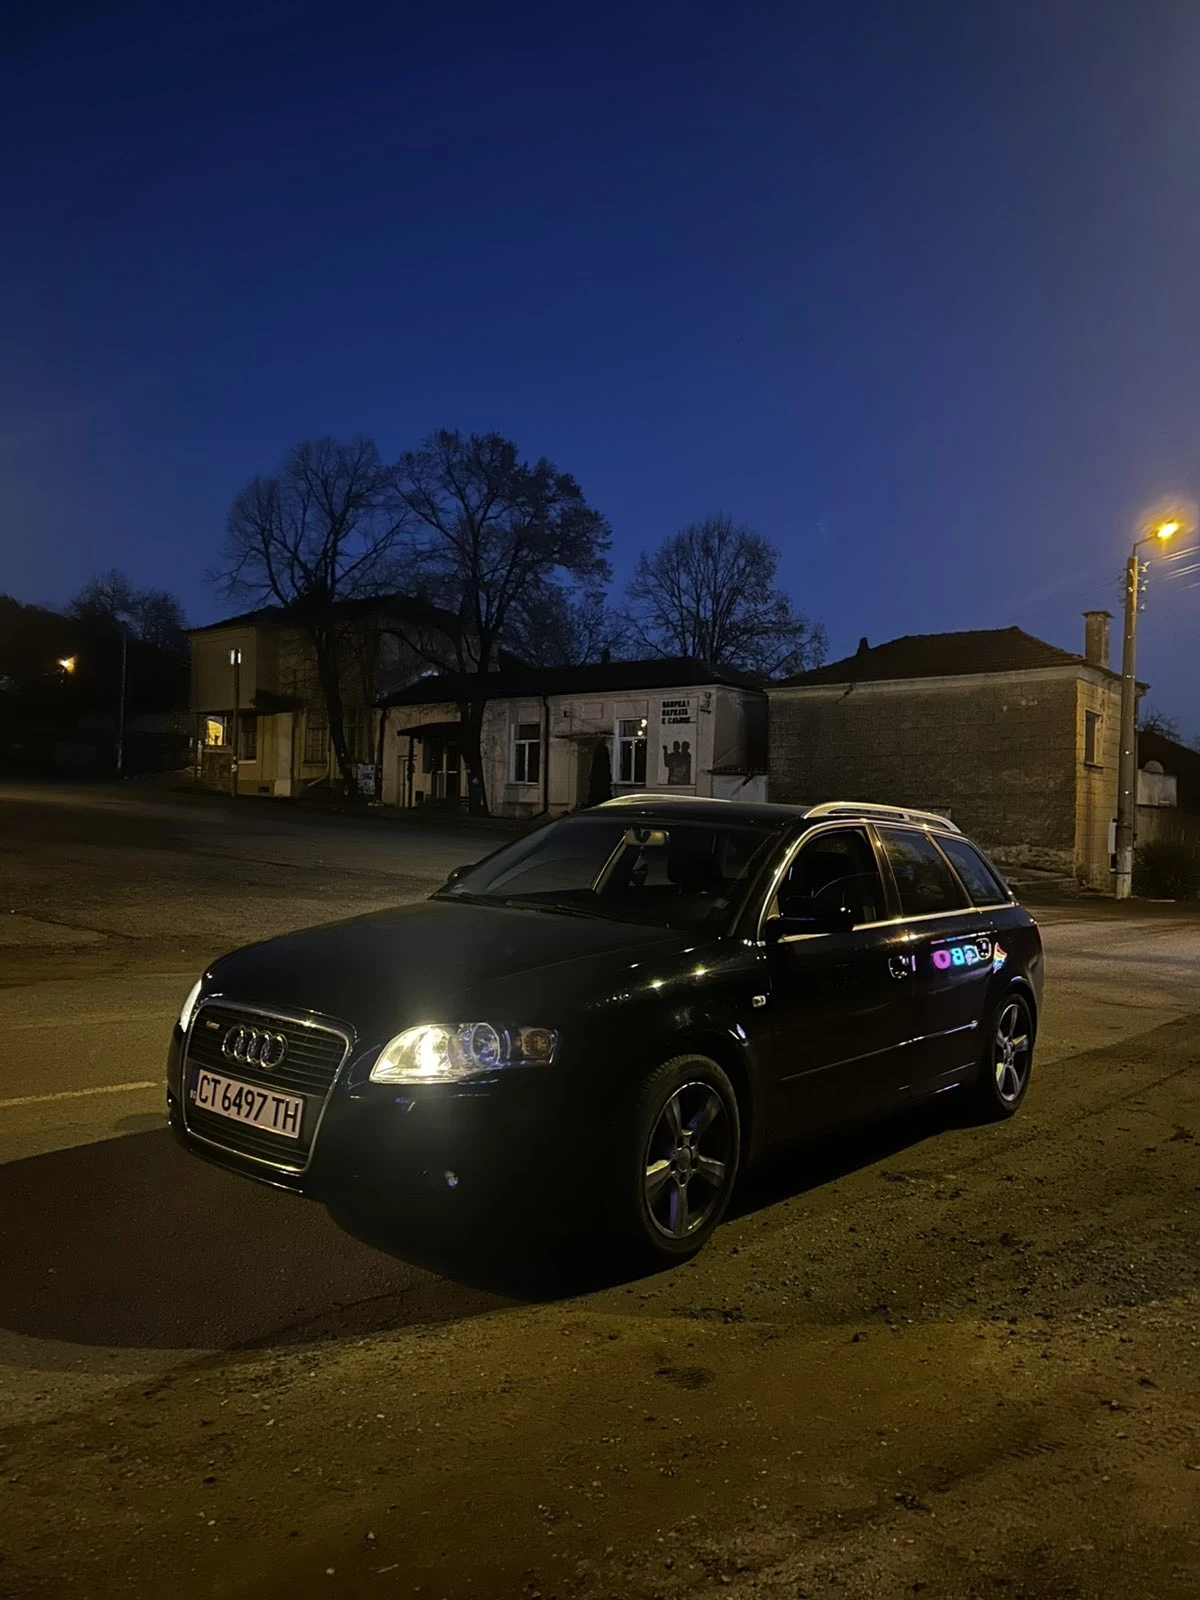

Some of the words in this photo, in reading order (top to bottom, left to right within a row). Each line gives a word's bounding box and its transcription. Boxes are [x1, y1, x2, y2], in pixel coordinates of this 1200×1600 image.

[199, 1075, 221, 1107] CT
[222, 1083, 268, 1121] 6497
[272, 1096, 299, 1133] TH
